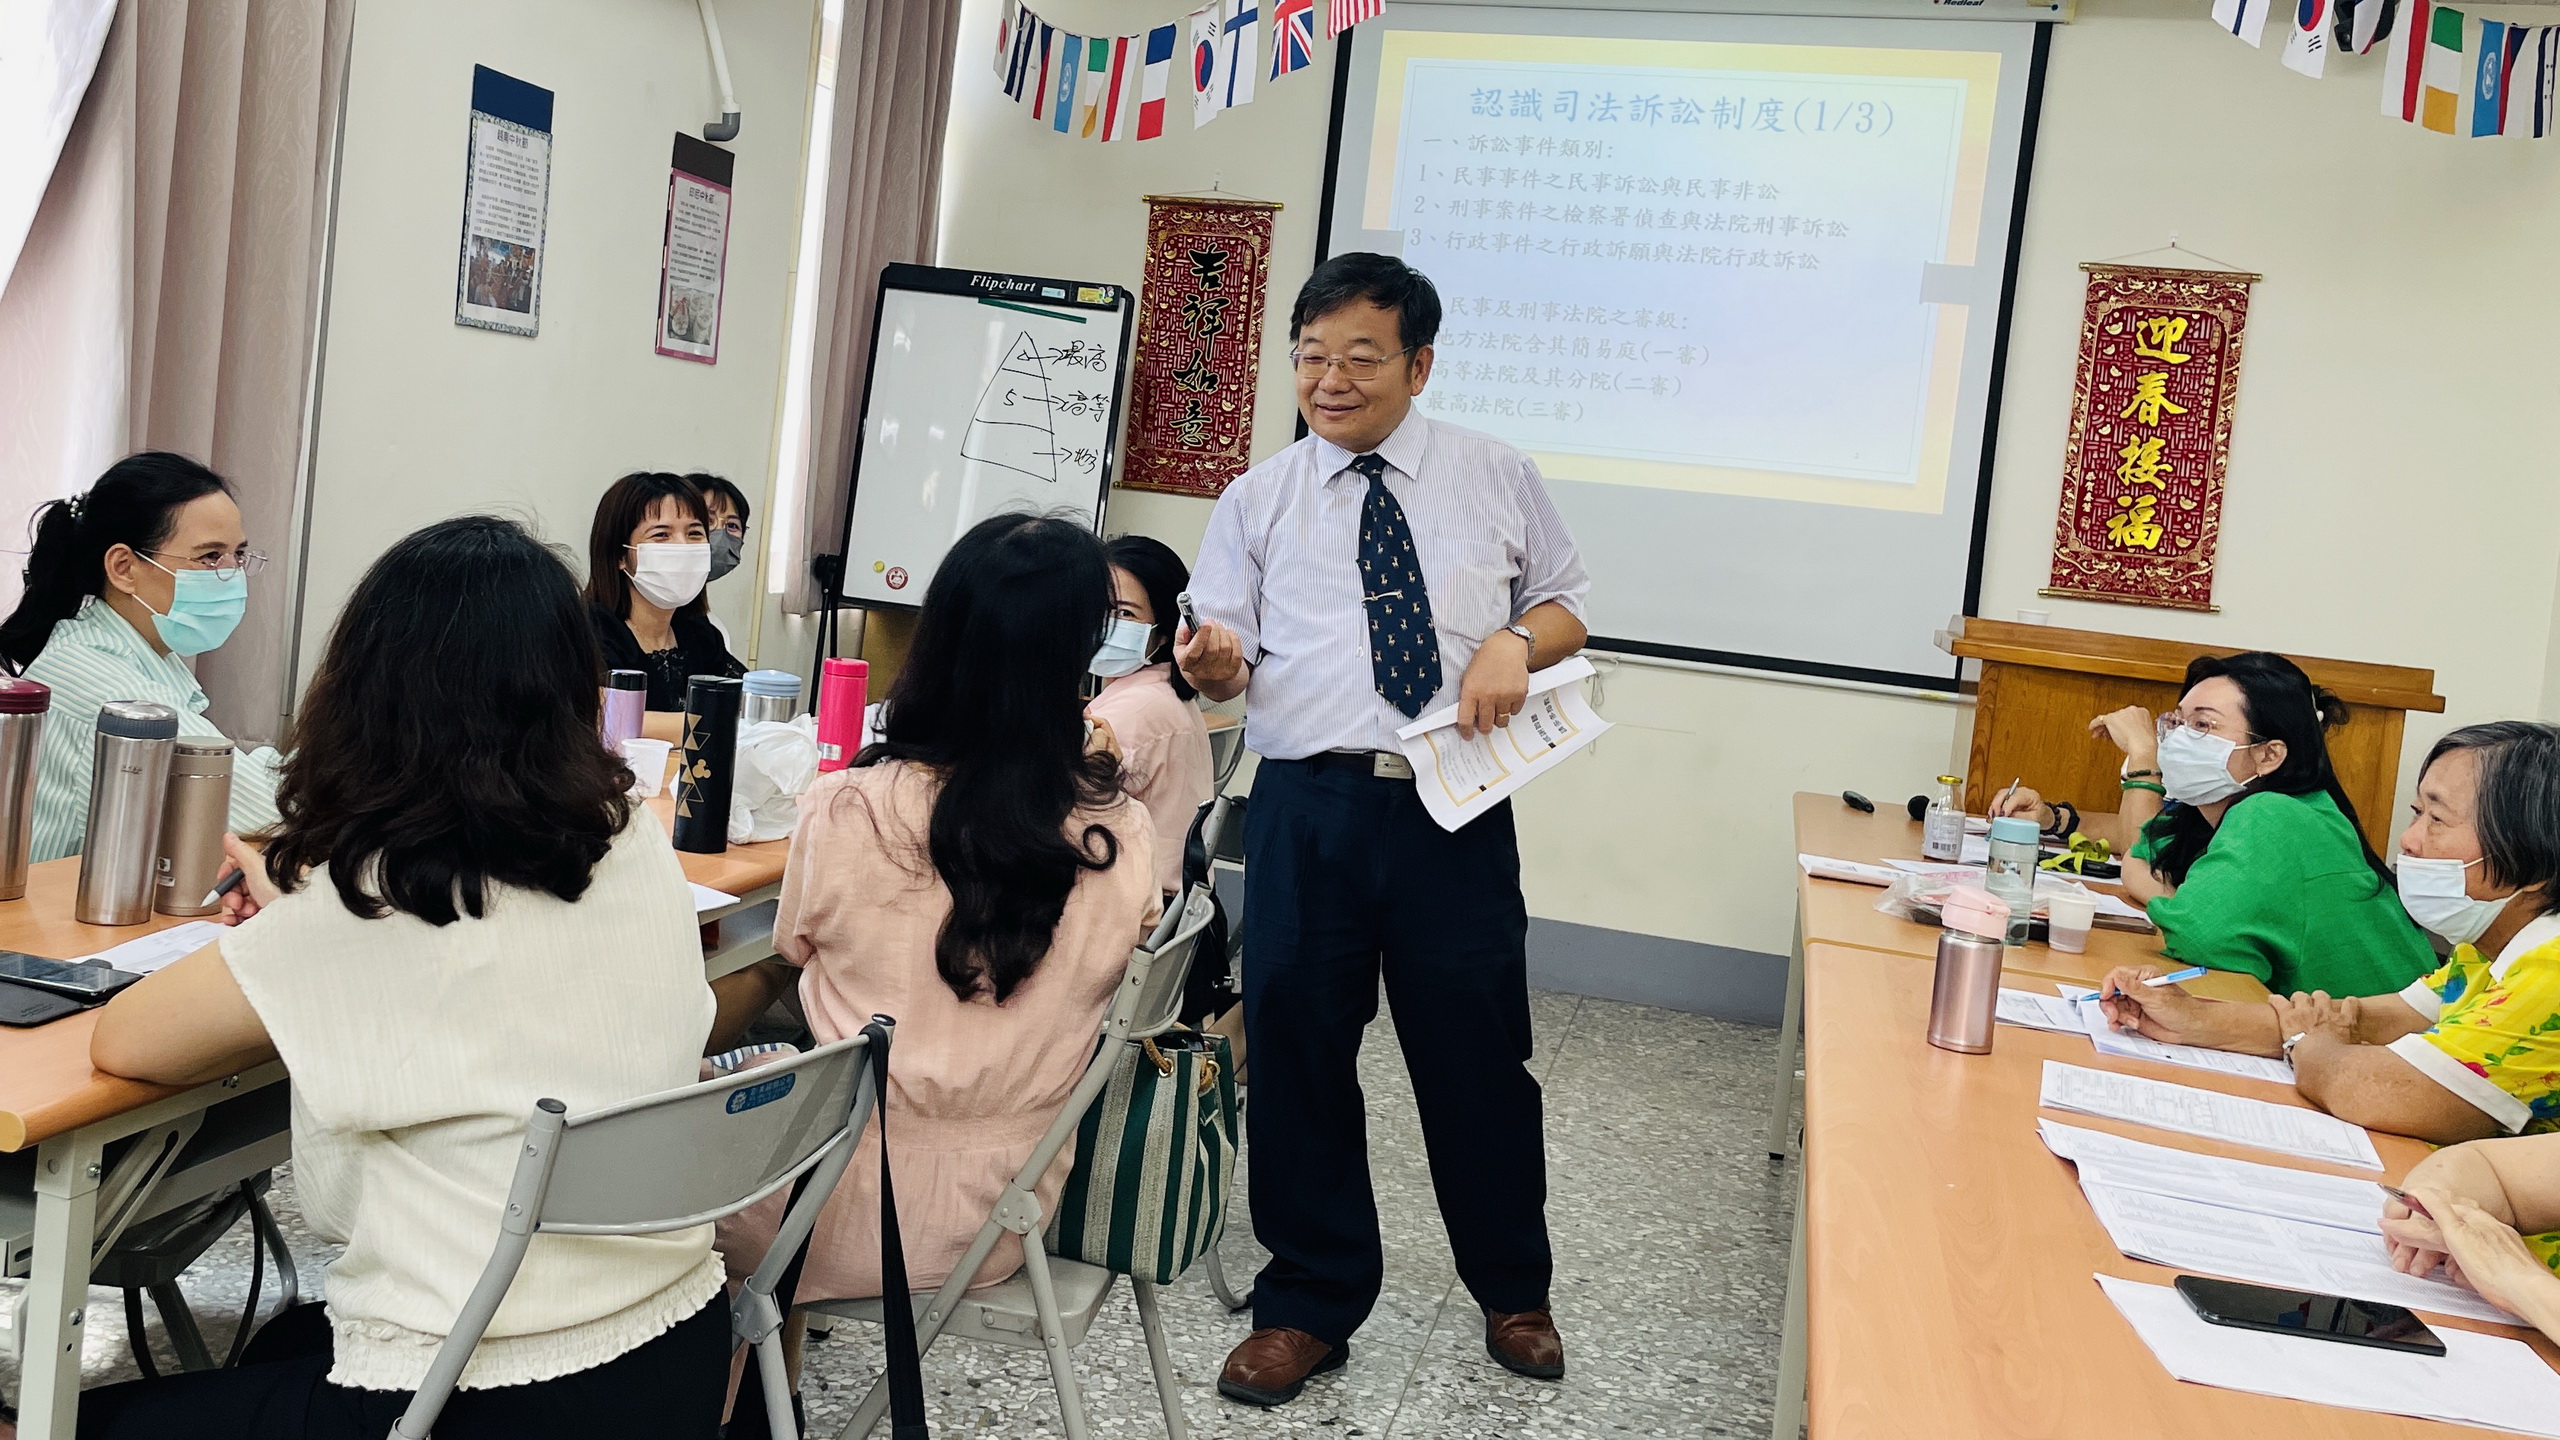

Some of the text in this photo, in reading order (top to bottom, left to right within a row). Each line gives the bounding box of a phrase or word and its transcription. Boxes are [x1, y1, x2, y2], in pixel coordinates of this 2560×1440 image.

[1469, 87, 1894, 138] 認識司法訴訟制度(1/3)
[1423, 133, 1614, 160] 一、訴訟事件類別:
[1418, 163, 1781, 201] 1、民事事件之民事訴訟與民事非訟
[1413, 195, 1850, 239] 2、刑事案件之檢察署偵查與法院刑事訴訟
[1409, 227, 1821, 271] 3、行政事件之行政訴願與法院行政訴訟
[970, 274, 1036, 292] Flipchart
[1169, 242, 1231, 446] 吉祥如意
[2105, 315, 2192, 550] 迎春接福
